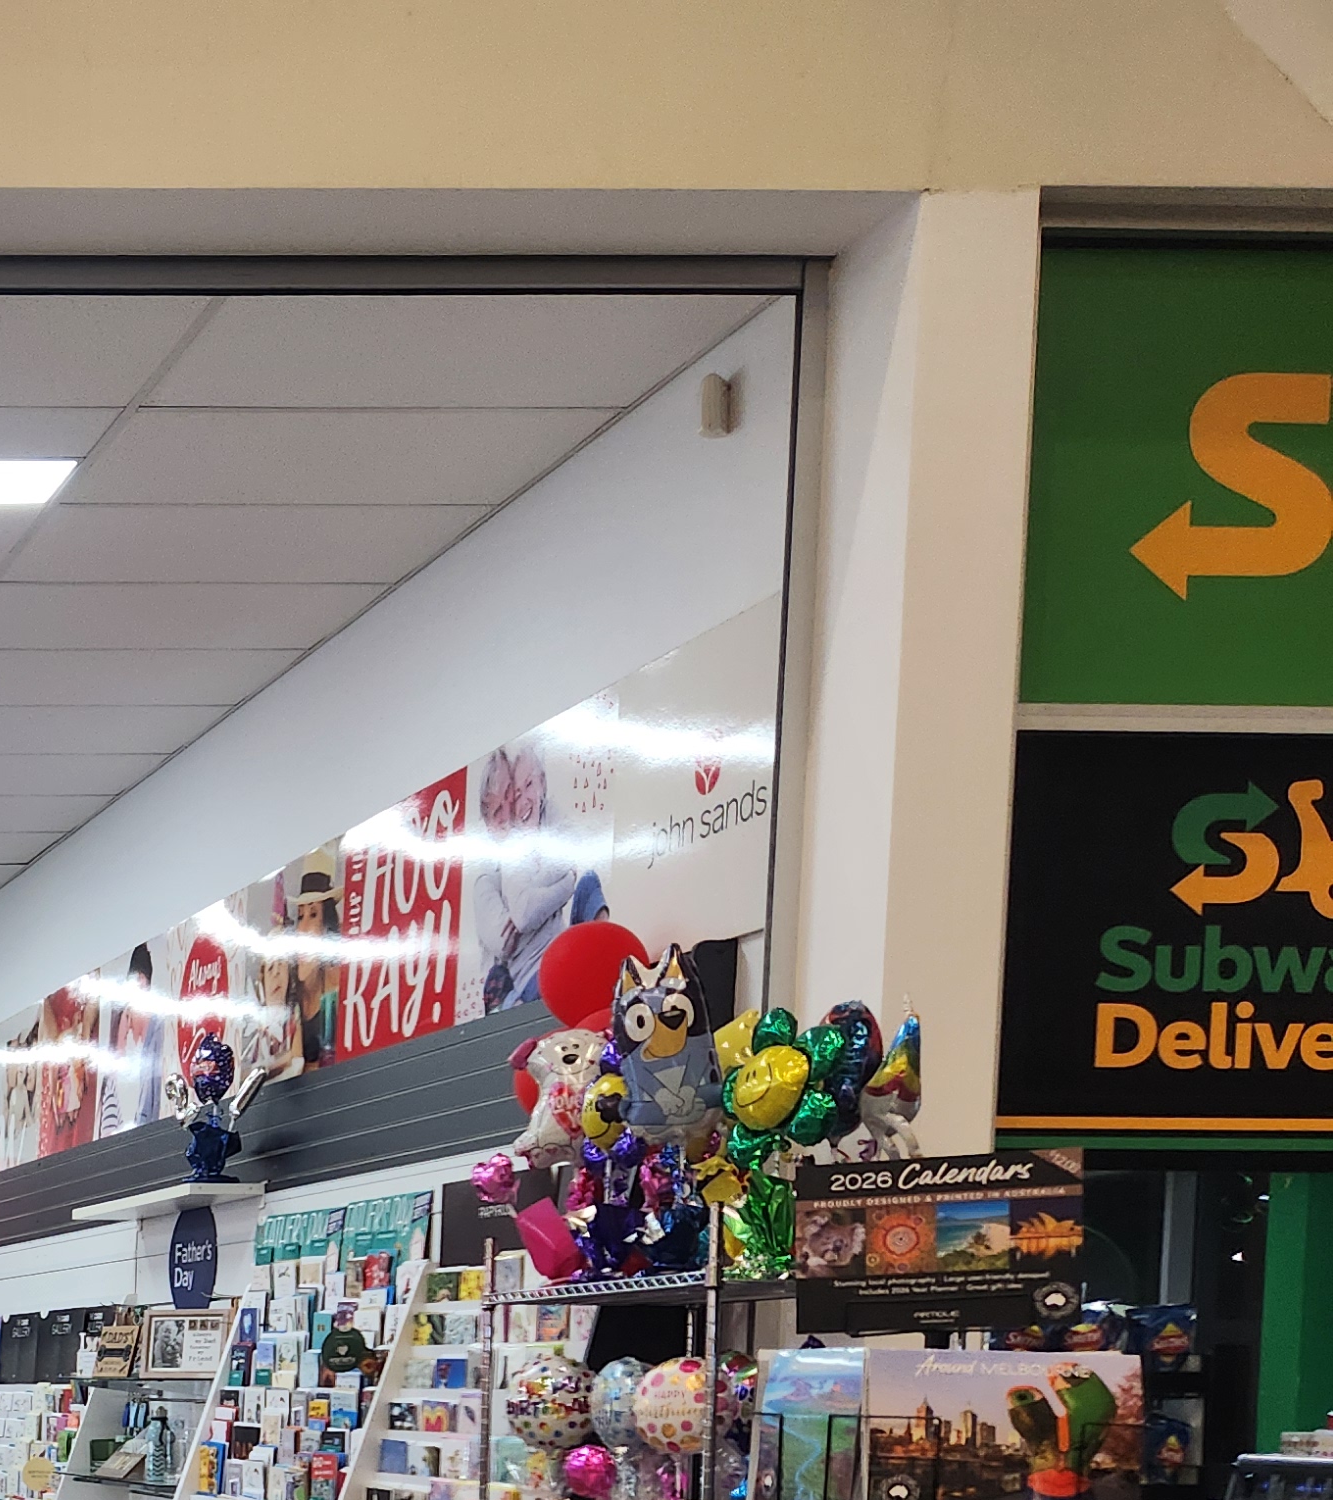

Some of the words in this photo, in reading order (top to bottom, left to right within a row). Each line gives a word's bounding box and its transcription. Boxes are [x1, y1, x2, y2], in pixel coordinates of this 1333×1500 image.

[646, 814, 696, 869] john
[699, 782, 768, 841] sands
[830, 1172, 893, 1192] 2026
[897, 1159, 1034, 1190] Calendars
[813, 1200, 863, 1209] PROUDLY
[866, 1197, 921, 1207] DESIGNED
[936, 1192, 981, 1201] PRINTED
[173, 1239, 213, 1265] Father's
[173, 1267, 194, 1290] Day
[915, 1355, 976, 1378] Around
[981, 1363, 1093, 1380] MELBOURNE
